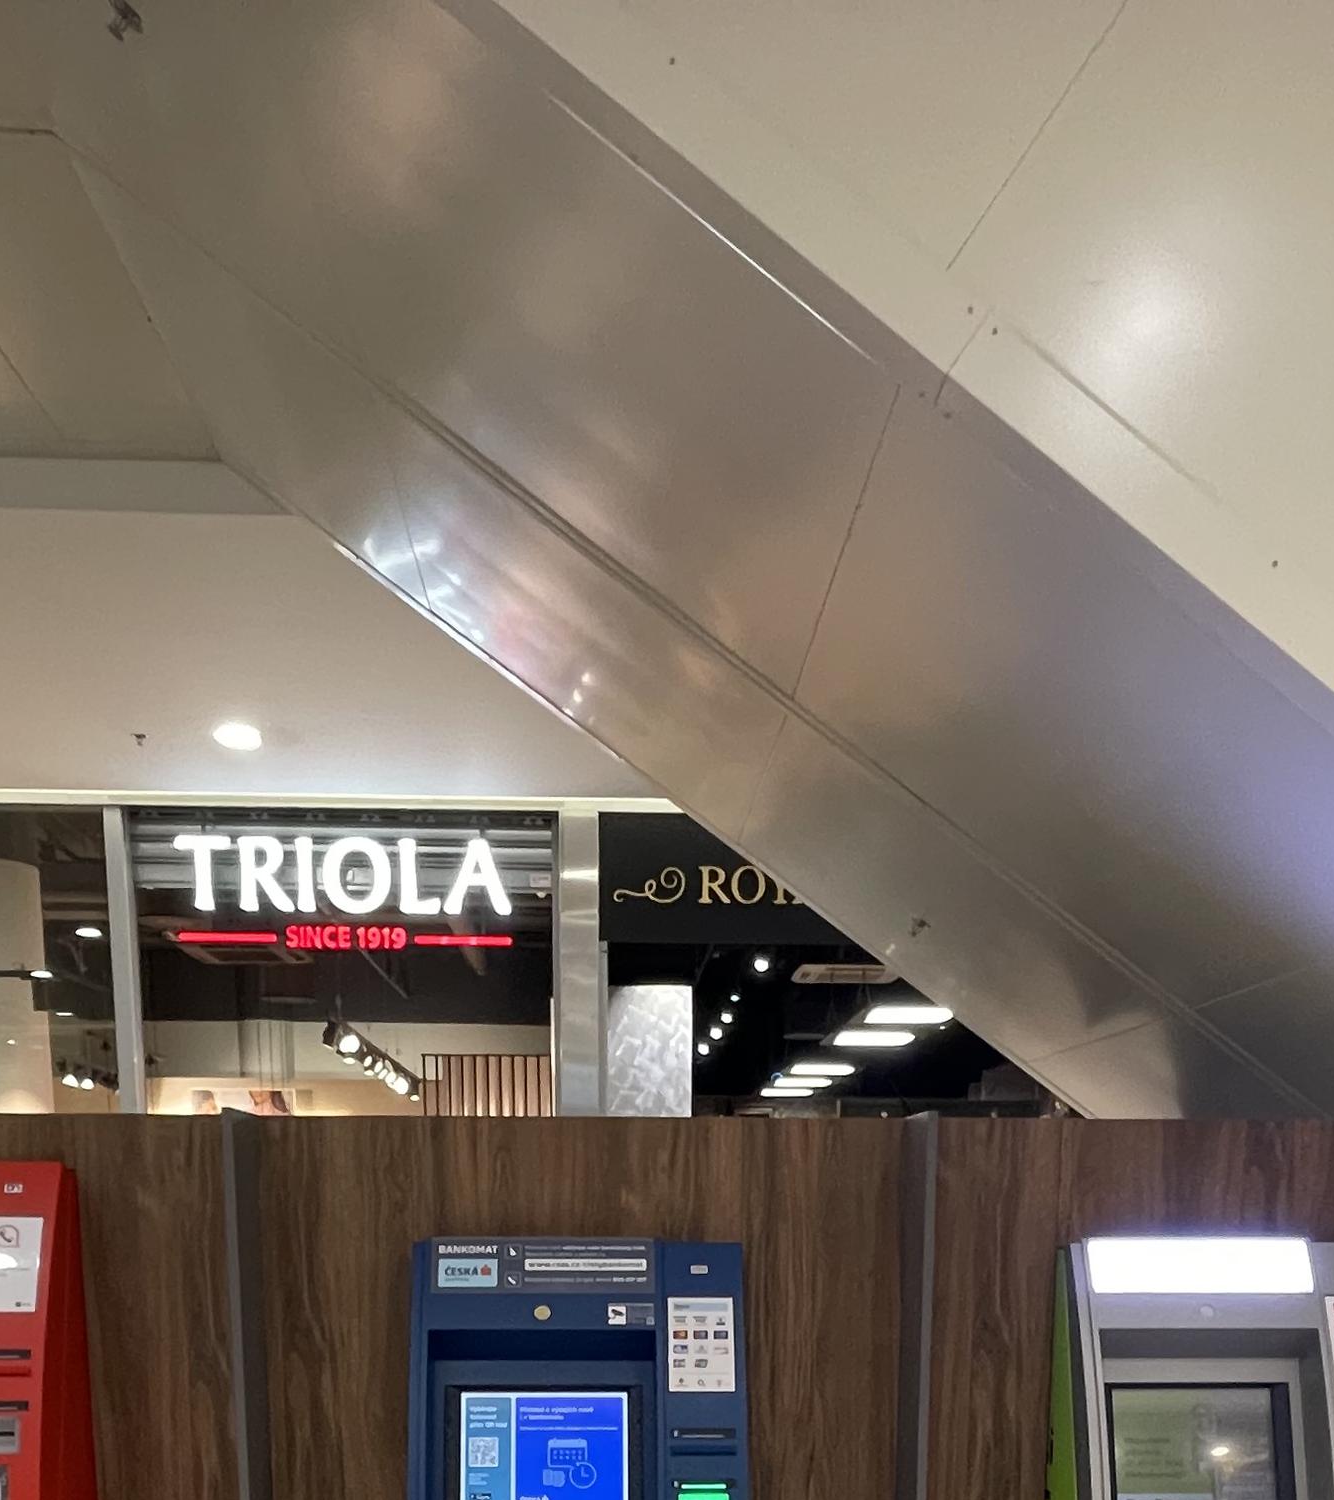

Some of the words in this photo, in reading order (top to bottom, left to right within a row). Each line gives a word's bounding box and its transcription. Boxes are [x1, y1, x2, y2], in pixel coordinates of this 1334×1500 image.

[173, 834, 513, 916] TRIOLA
[285, 925, 351, 949] SINCE
[356, 926, 407, 950] 1919
[438, 1244, 497, 1255] BANKOMAT
